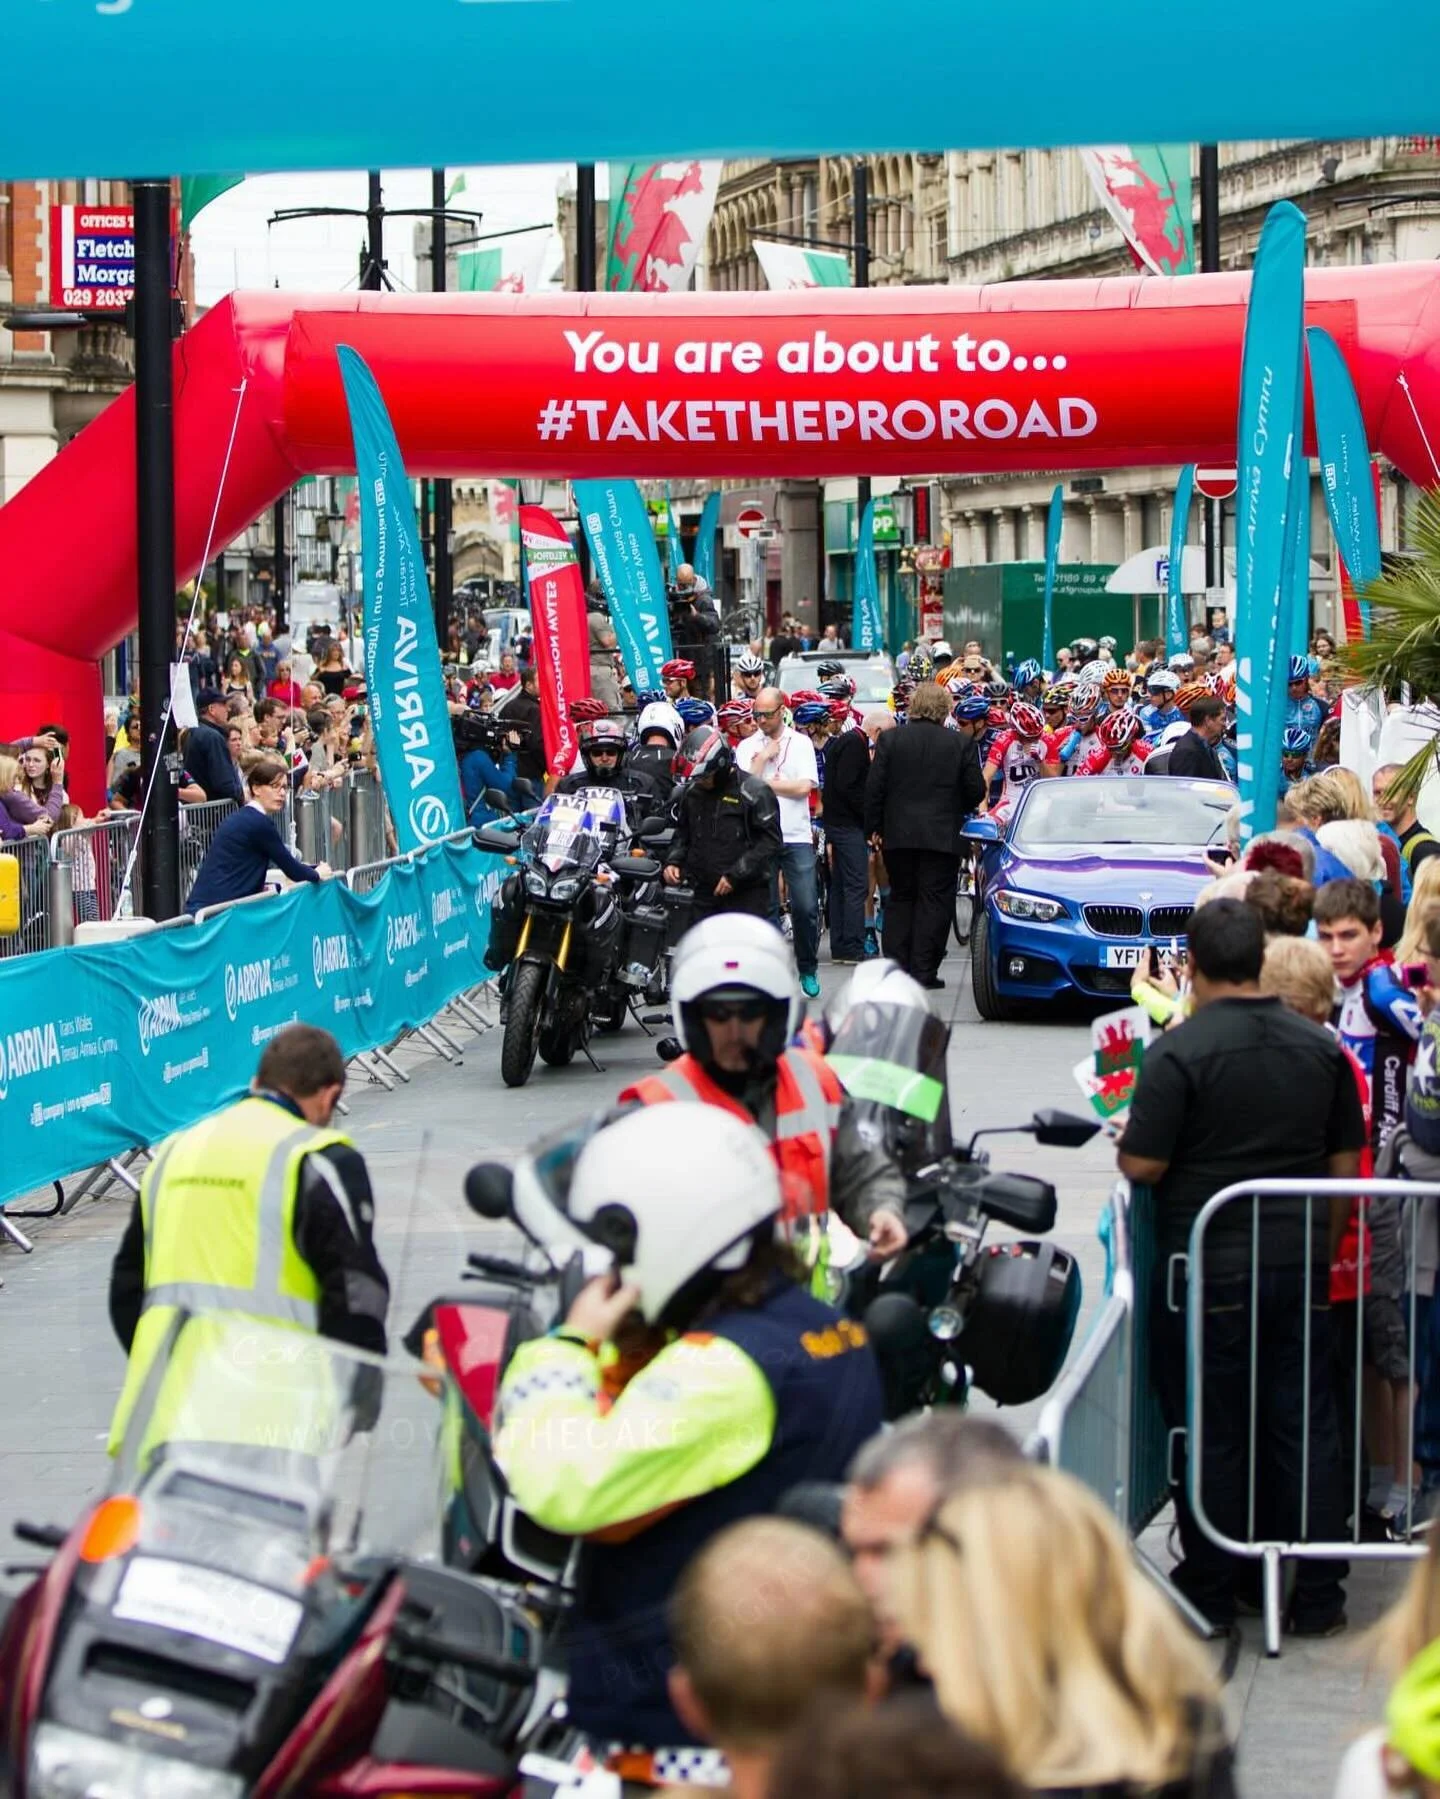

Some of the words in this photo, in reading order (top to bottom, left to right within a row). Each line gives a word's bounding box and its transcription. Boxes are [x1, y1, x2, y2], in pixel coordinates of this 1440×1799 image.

[80, 215, 127, 229] OFFICES
[63, 289, 92, 306] 029
[96, 289, 134, 306] 2037
[563, 330, 660, 375] You
[674, 339, 763, 375] are
[777, 330, 940, 374] about
[952, 332, 1068, 373] to...
[536, 397, 1098, 442] #TAKETHEPROROAD
[1253, 365, 1274, 456] Cymru
[860, 598, 873, 650] RRIVA
[556, 796, 587, 812] TV1
[584, 788, 615, 800] TV4
[237, 958, 272, 1006] ARRIVA
[7, 1022, 60, 1080] ARRIVA
[1384, 1056, 1400, 1113] Cardiff
